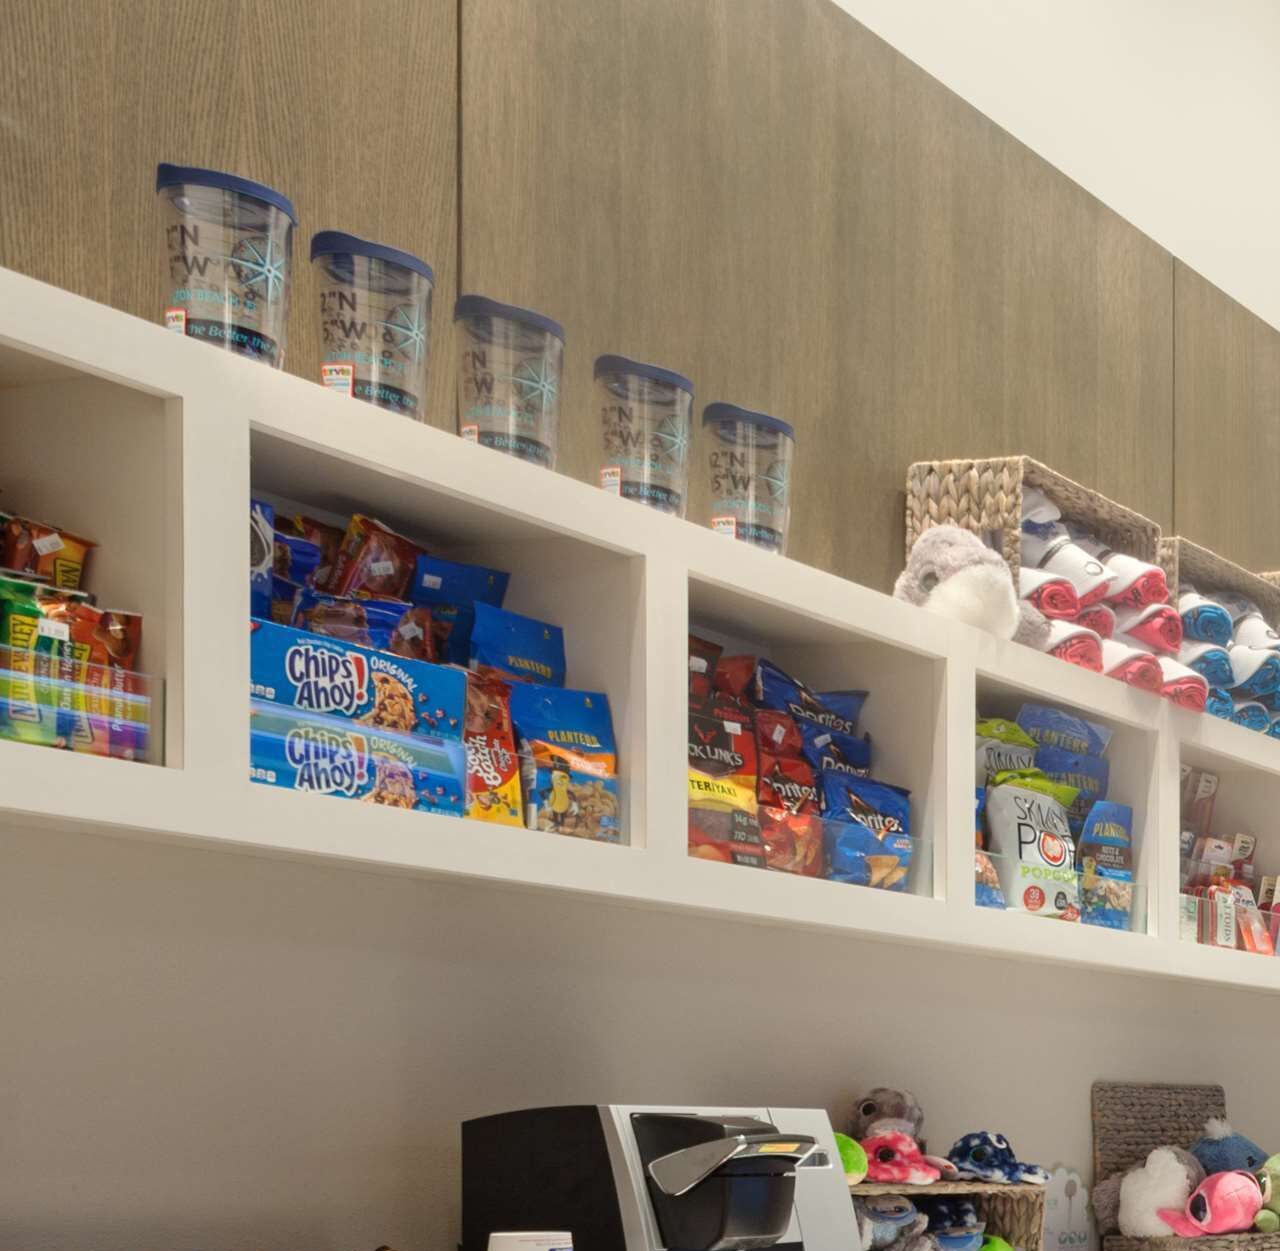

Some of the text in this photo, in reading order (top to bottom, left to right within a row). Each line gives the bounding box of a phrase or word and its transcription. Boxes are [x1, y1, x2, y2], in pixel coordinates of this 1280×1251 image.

[287, 646, 354, 684] Chips
[370, 656, 418, 693] ORIGINAL
[287, 728, 354, 766] Chips
[689, 778, 737, 797] TERIYAKI
[1221, 896, 1233, 943] ALTOIDS
